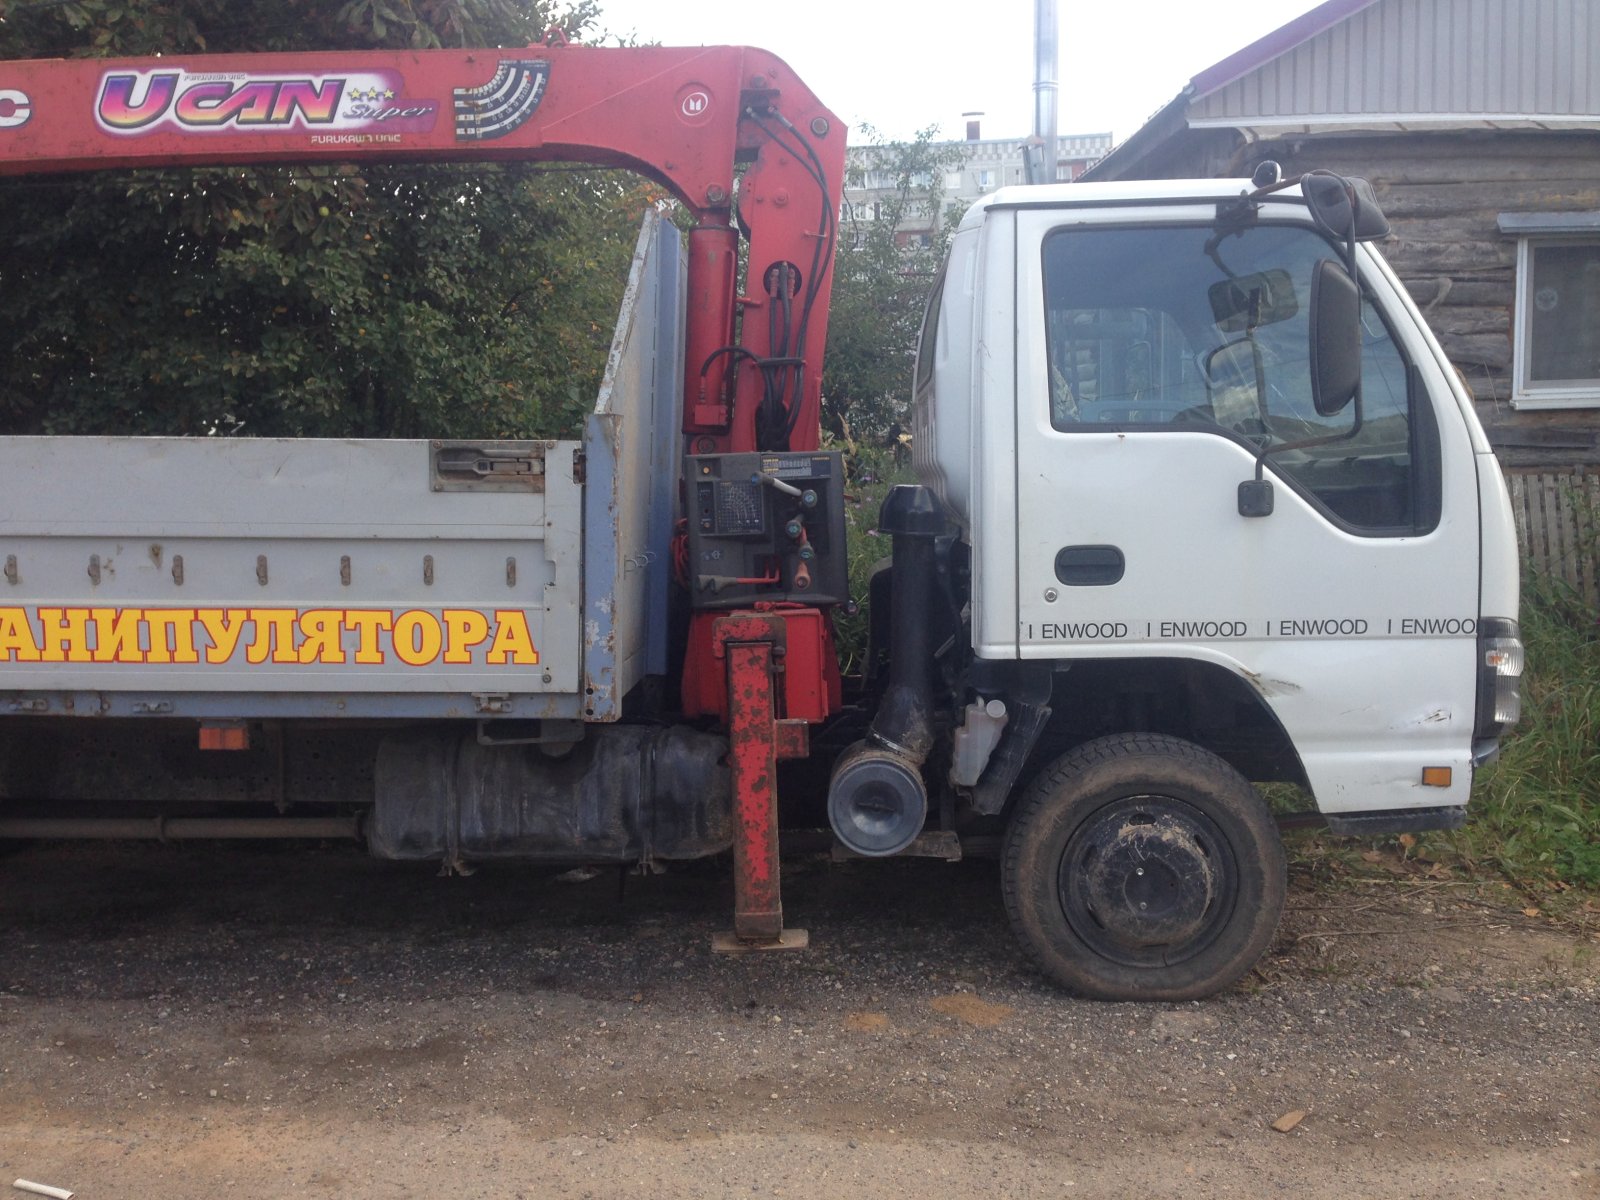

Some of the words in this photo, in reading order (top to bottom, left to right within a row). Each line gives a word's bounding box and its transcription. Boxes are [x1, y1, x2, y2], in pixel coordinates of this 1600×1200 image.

[342, 104, 433, 120] Super
[1402, 618, 1479, 634] ENWOO
[0, 606, 540, 666] АНИПУЛЯТОРА
